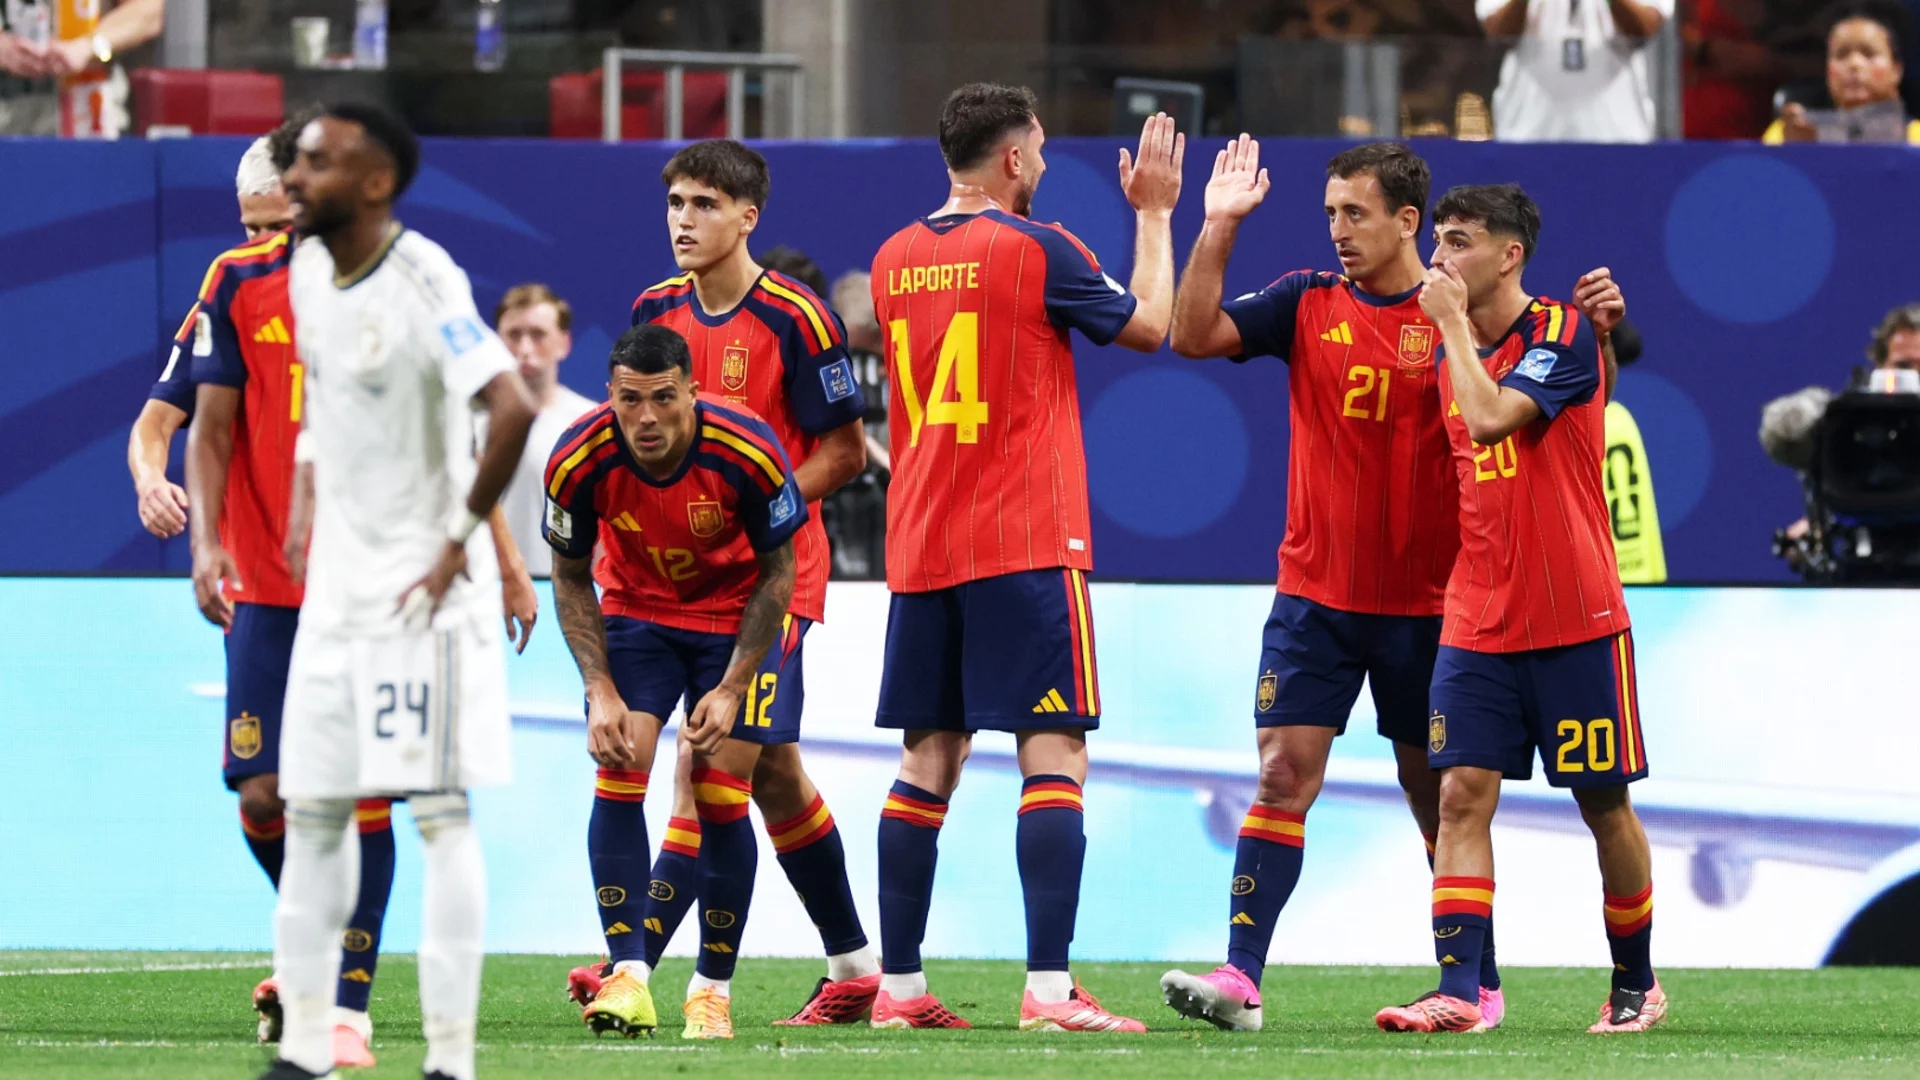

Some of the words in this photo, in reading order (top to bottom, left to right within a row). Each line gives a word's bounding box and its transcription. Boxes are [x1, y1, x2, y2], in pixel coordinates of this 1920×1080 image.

[889, 262, 980, 296] LAPORTE
[289, 363, 304, 423] 1
[888, 311, 989, 449] 14
[1343, 365, 1390, 422] 21
[1471, 435, 1518, 482] 20
[646, 546, 700, 581] 12
[376, 682, 429, 738] 24
[744, 672, 777, 728] 12
[1557, 718, 1615, 773] 20
